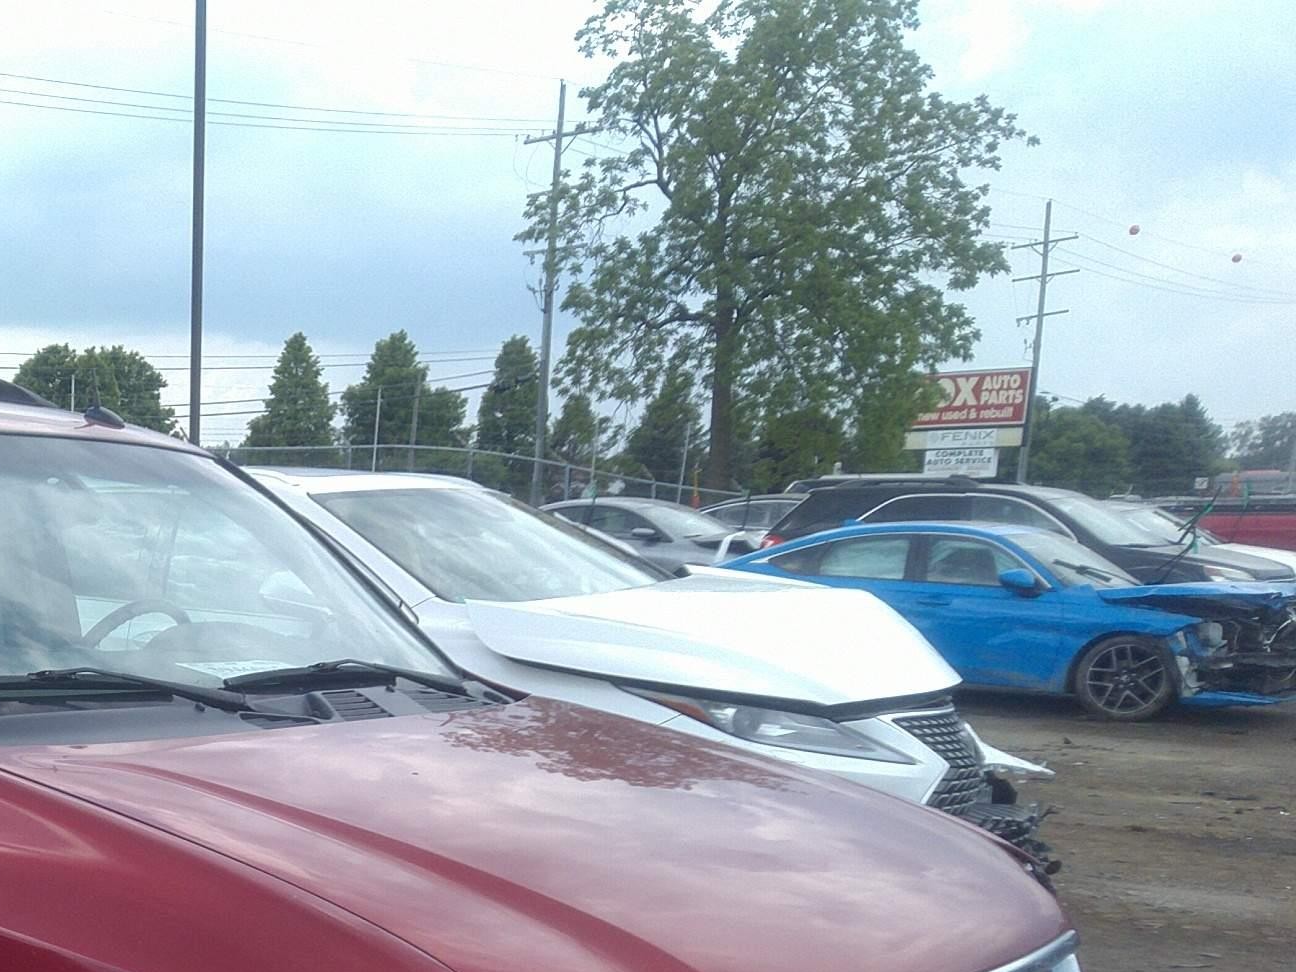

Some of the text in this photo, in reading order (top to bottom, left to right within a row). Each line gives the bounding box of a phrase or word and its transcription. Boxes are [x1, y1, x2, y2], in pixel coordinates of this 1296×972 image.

[981, 374, 1021, 390] AUTO
[932, 377, 980, 408] OX
[979, 389, 1024, 405] PARTS
[942, 408, 968, 420] used
[979, 406, 1014, 419] rebuilt
[940, 430, 995, 441] FENIX
[926, 456, 992, 465] AUTO SERVICE
[935, 449, 984, 458] COMPLETE
